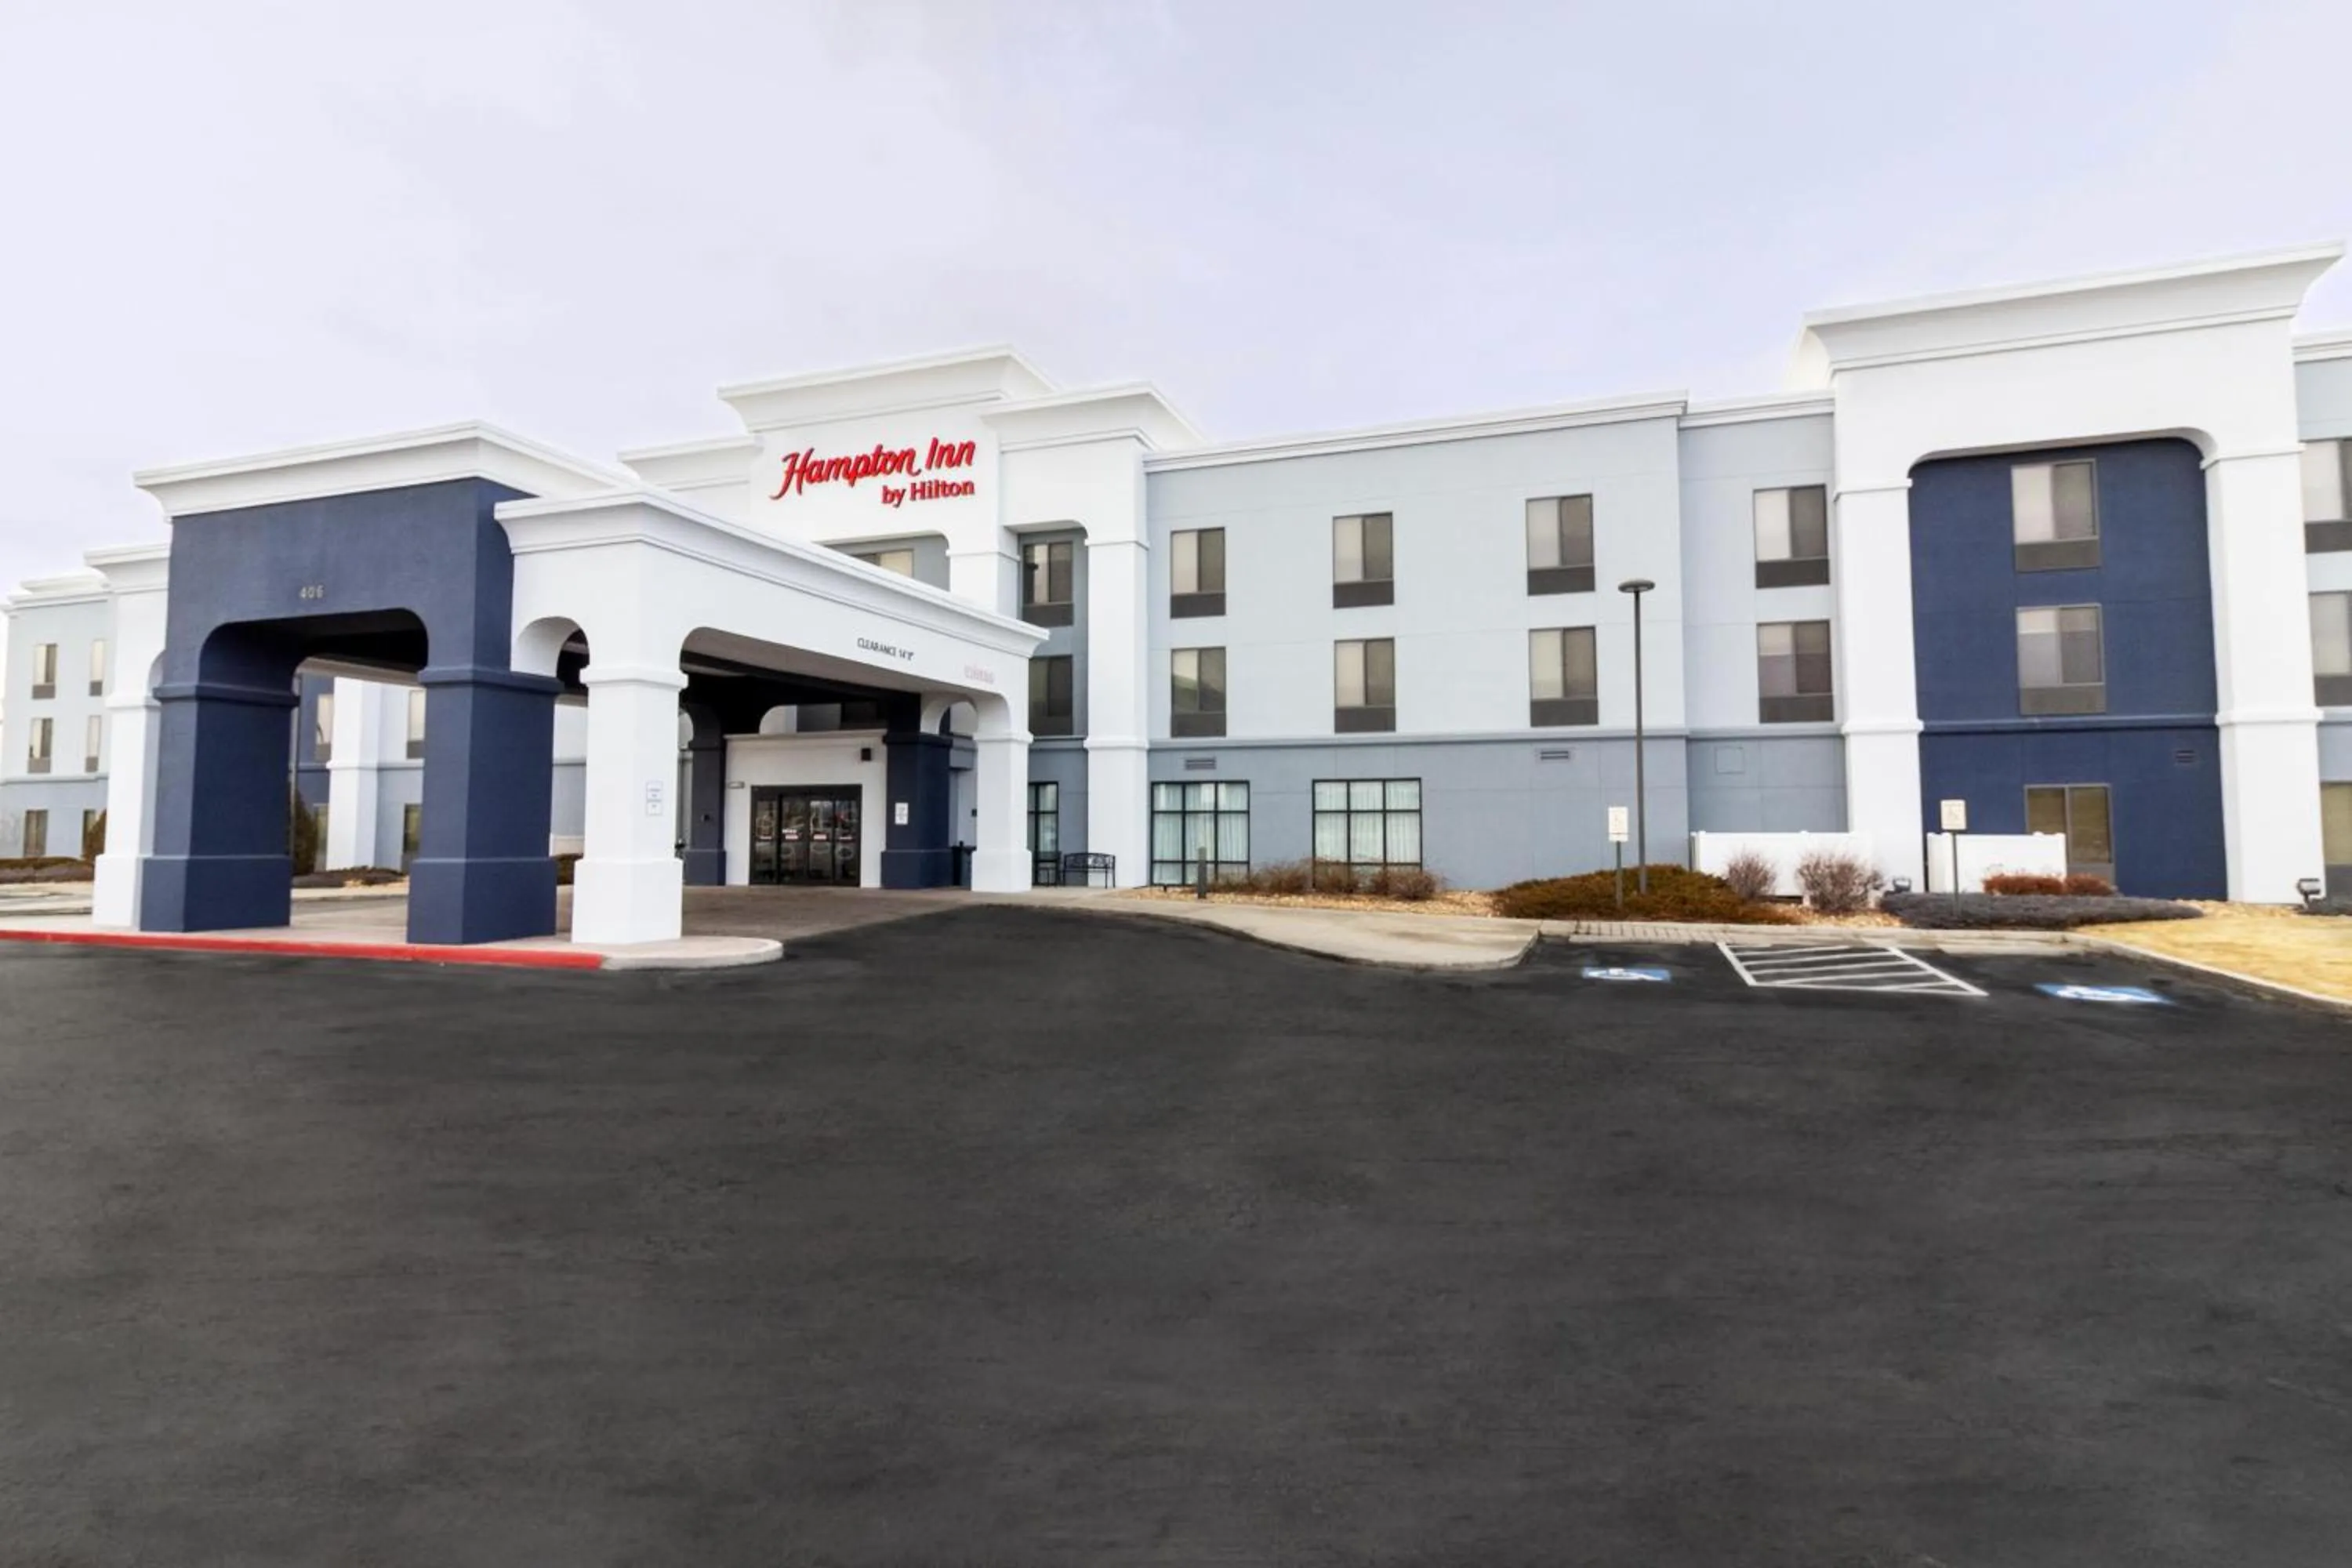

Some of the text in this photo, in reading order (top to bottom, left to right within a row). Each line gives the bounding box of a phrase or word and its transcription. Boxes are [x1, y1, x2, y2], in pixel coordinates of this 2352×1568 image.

[769, 437, 977, 500] Hampton Inn
[881, 479, 975, 508] by Hilton
[857, 637, 897, 656] CLEARANCE
